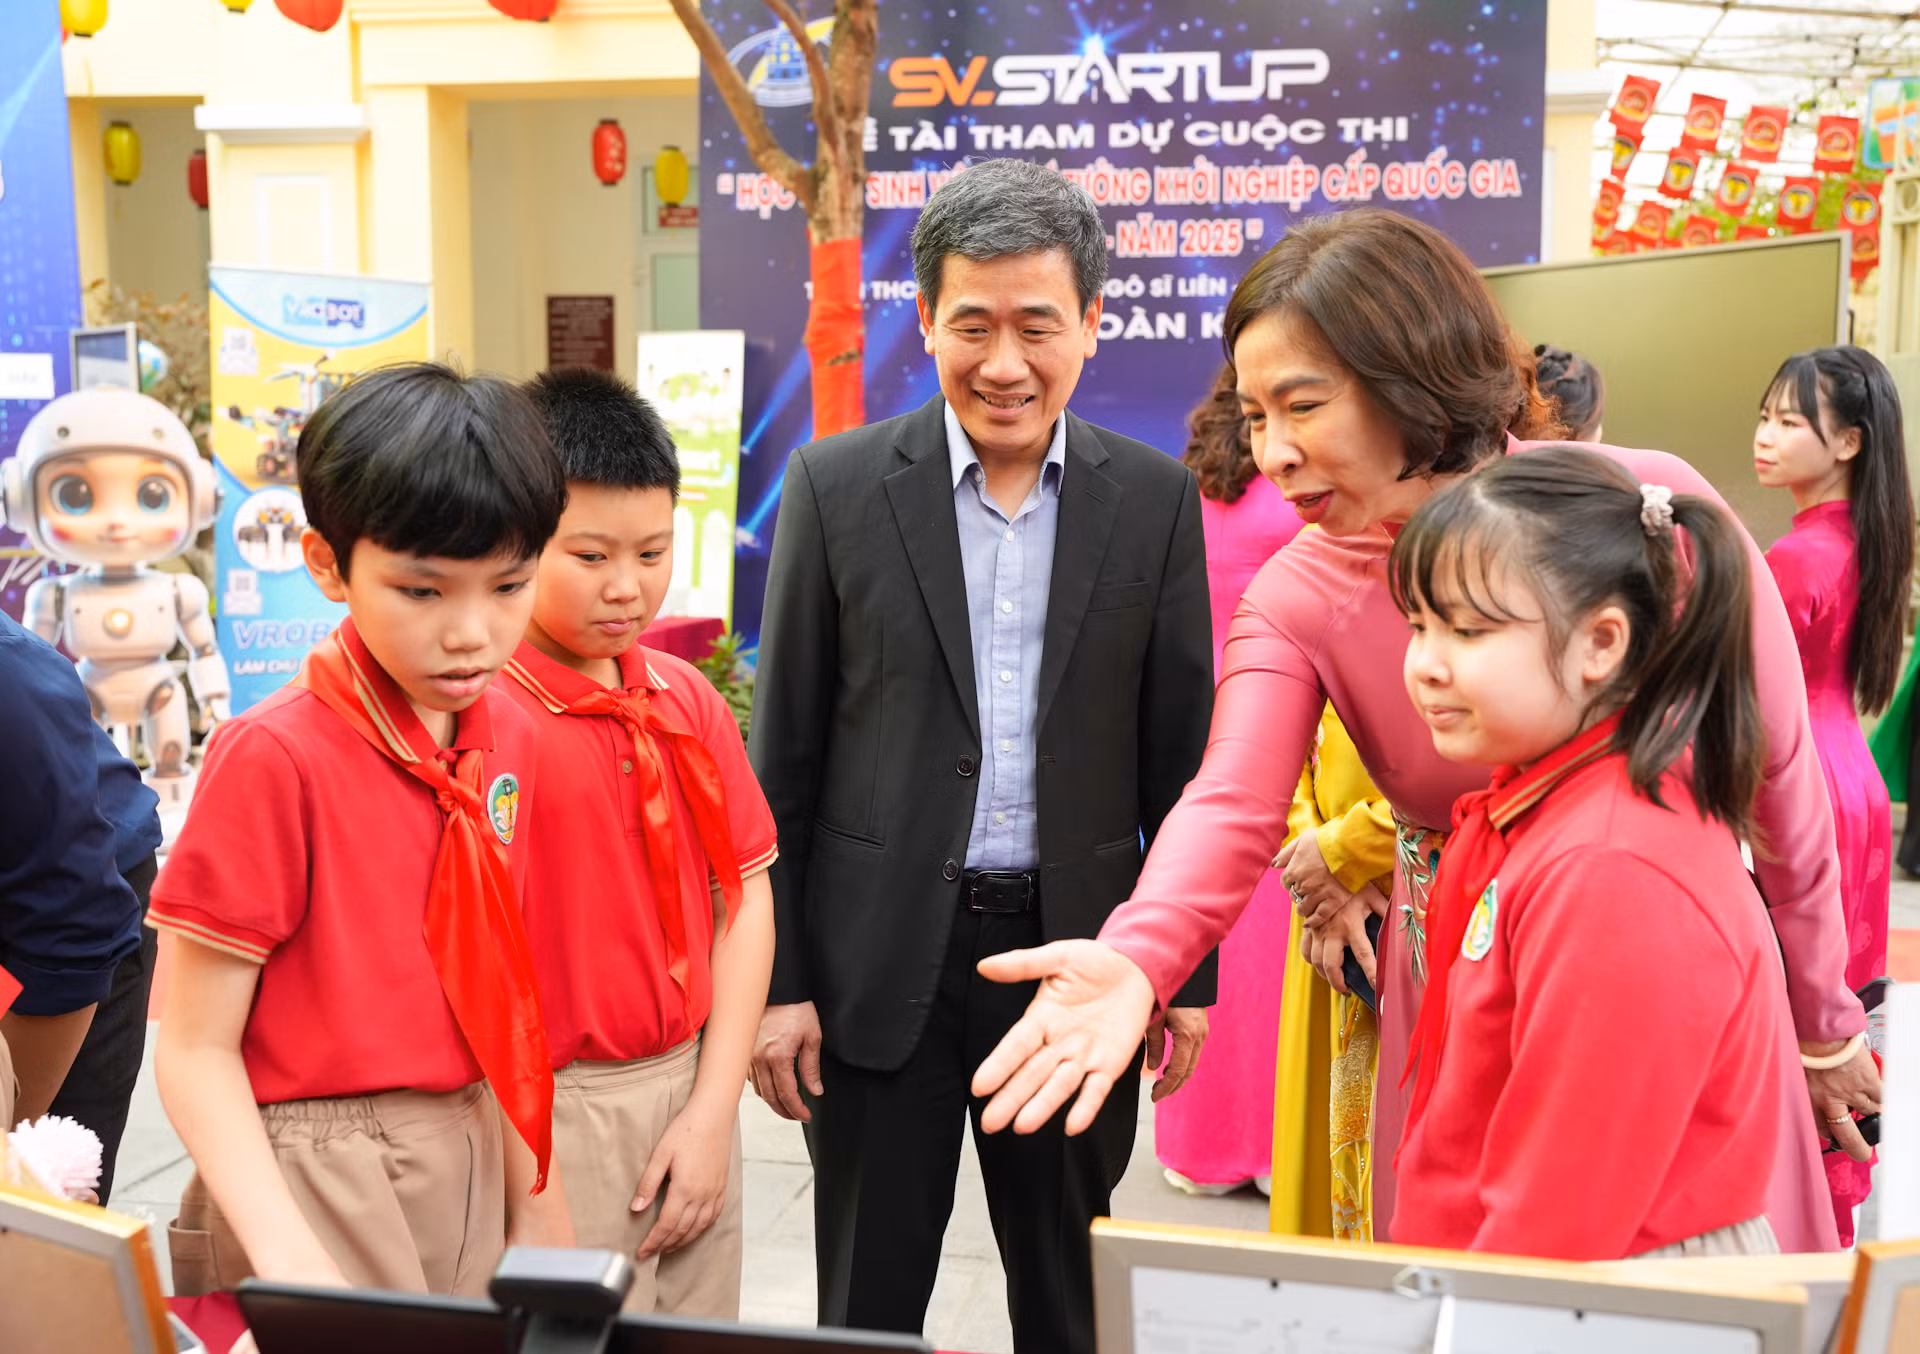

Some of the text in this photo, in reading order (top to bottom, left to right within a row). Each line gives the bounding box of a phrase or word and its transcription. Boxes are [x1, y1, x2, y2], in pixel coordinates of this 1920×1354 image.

[888, 119, 957, 151] TÀI
[969, 122, 1095, 150] THAM
[1108, 118, 1175, 154] DỰ
[1184, 113, 1326, 151] CUỘC
[1337, 116, 1409, 142] THI
[865, 170, 926, 209] SINH
[1153, 154, 1220, 205] KHỞI
[1223, 154, 1321, 212] NGHIỆP
[1321, 146, 1381, 202] CẤP
[1382, 144, 1467, 200] QUỐC
[1467, 159, 1523, 198] GIA
[1115, 212, 1178, 258] NĂM
[1179, 218, 1244, 257] 2025
[870, 279, 920, 301] THC
[1102, 273, 1146, 299] GÔ
[1177, 273, 1228, 297] LIÊN
[1097, 306, 1187, 341] OÀN
[231, 617, 332, 650] VROB
